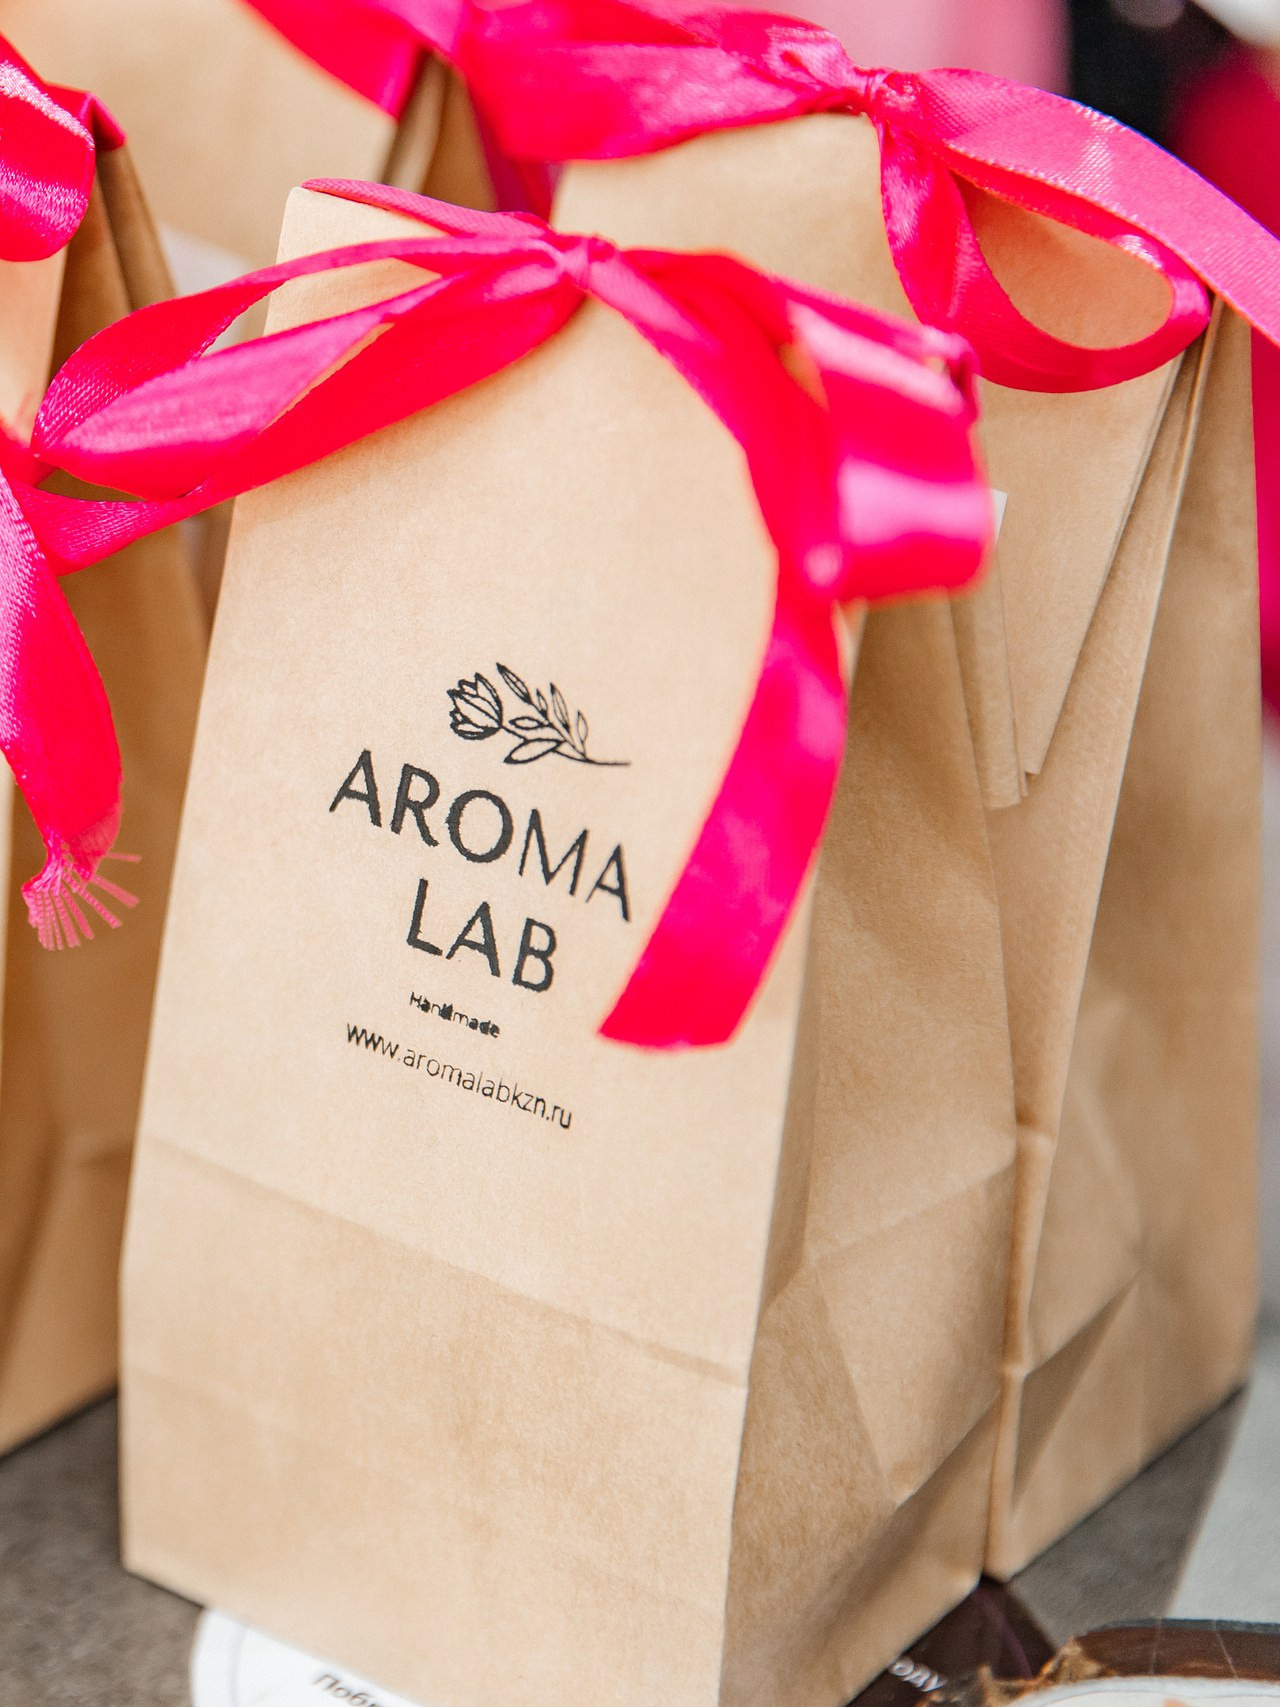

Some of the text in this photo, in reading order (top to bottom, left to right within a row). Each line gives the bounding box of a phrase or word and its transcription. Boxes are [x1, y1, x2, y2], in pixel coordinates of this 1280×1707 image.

[328, 748, 632, 923] AROMA
[406, 877, 558, 994] LAB
[408, 990, 502, 1040] Handmade
[345, 1022, 574, 1131] www.aromalabkzn.ru
